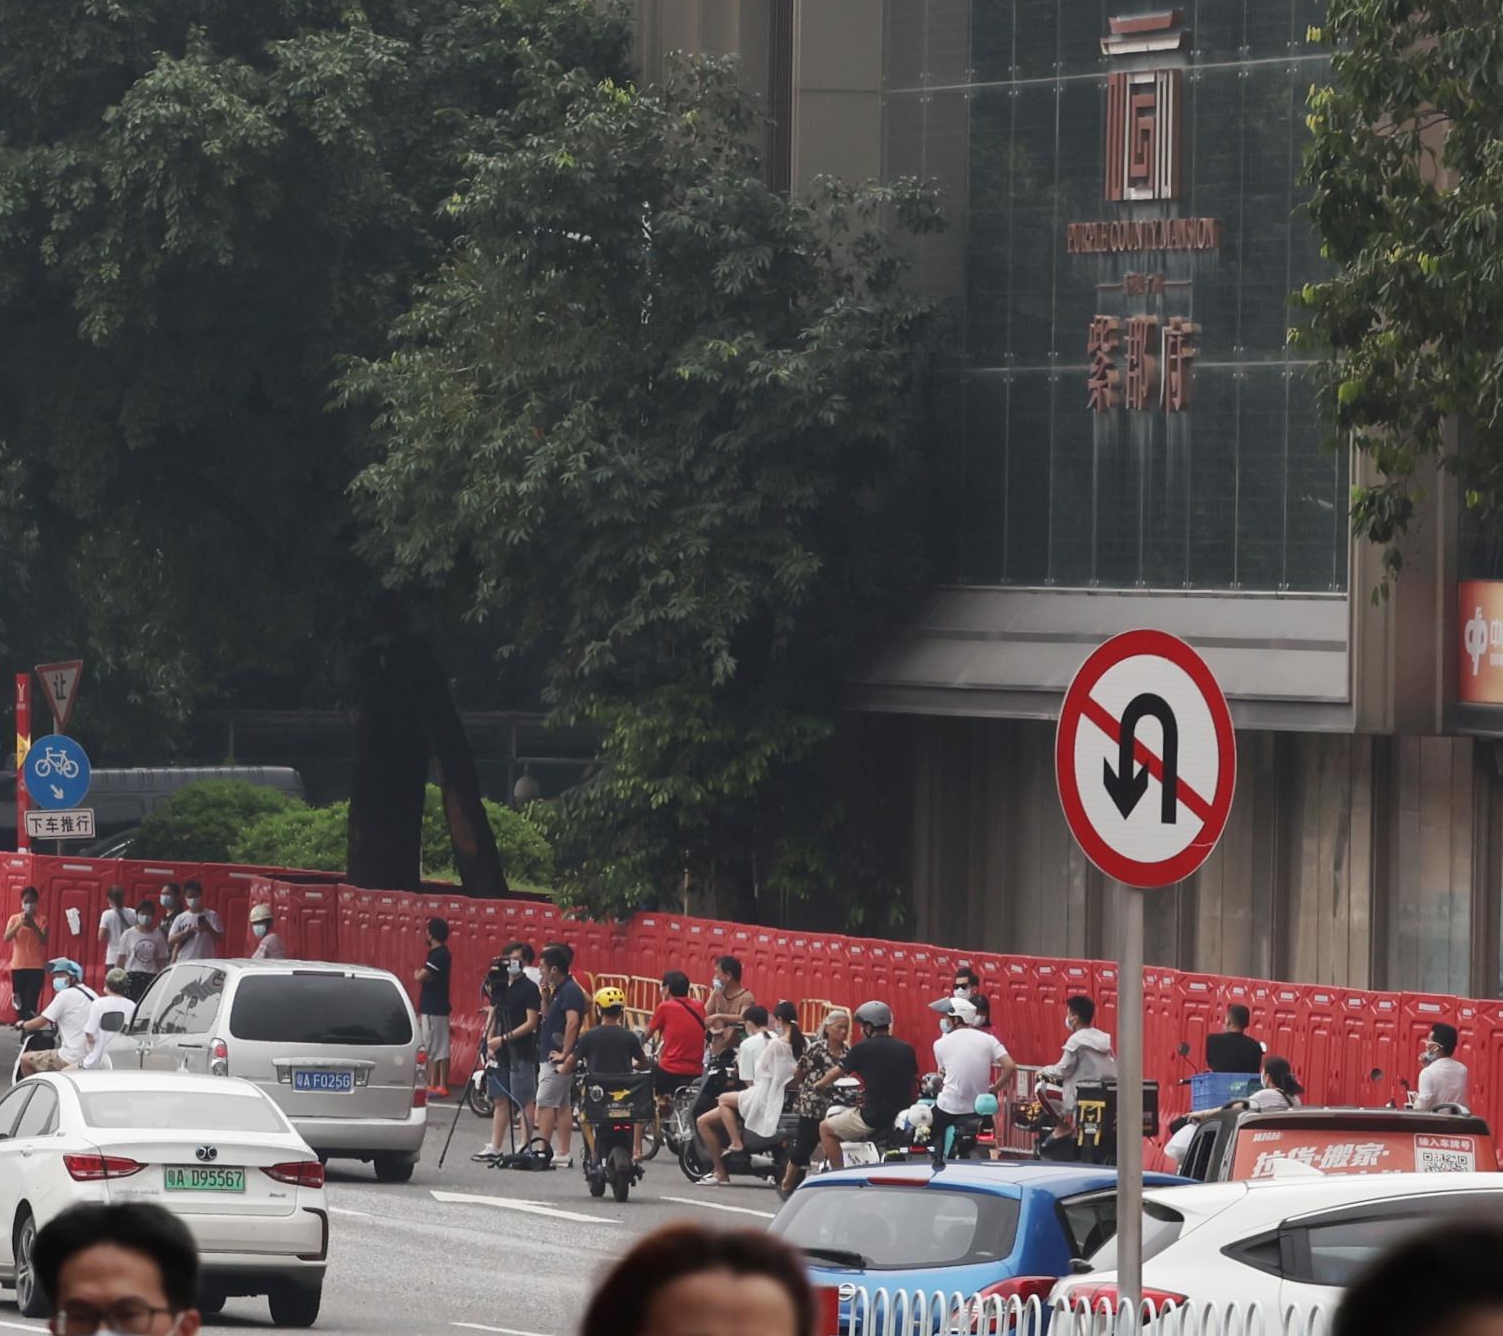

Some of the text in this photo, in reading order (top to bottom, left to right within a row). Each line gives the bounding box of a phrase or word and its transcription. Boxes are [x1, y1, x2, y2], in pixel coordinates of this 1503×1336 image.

[53, 672, 67, 701] 让
[29, 814, 90, 834] 下车推行
[1419, 1137, 1470, 1150] 输入车牌号
